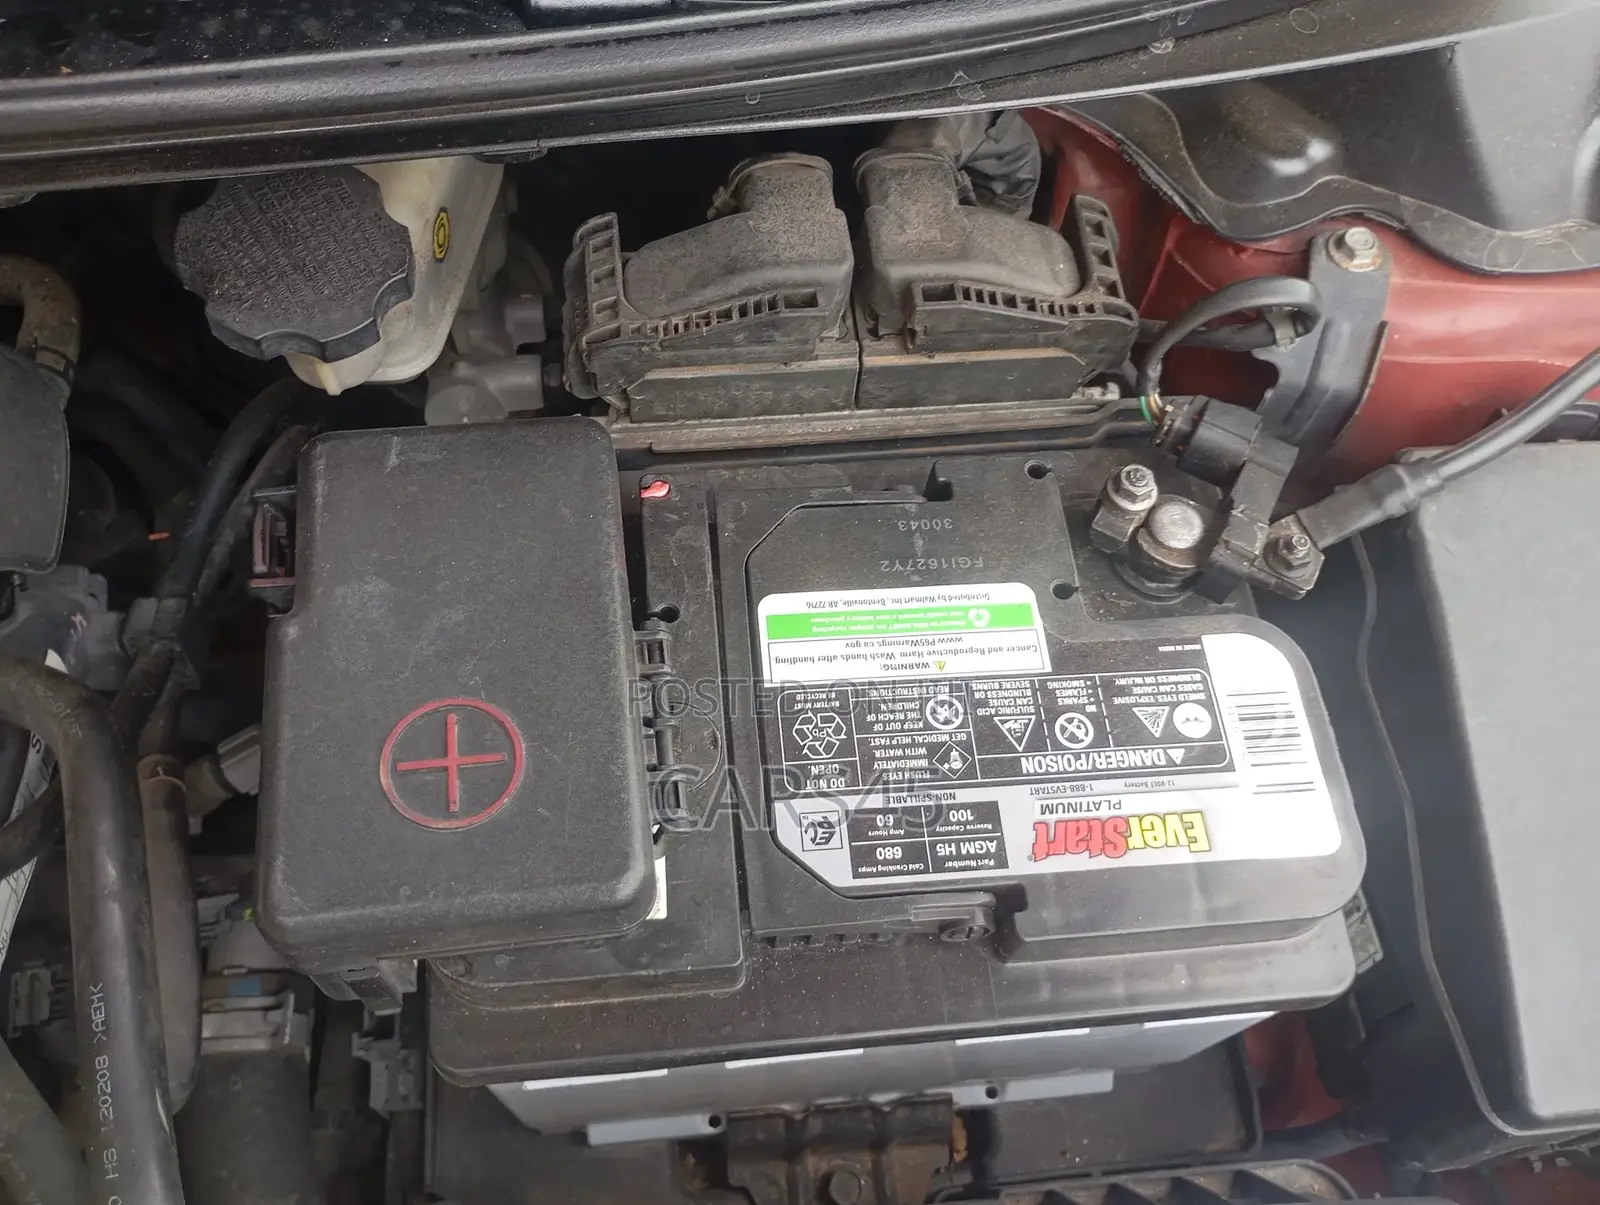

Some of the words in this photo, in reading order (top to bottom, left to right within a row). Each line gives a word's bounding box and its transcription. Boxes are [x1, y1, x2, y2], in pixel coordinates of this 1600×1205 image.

[904, 596, 936, 604] Walmart
[938, 594, 946, 602] by
[947, 593, 990, 602] Distributed
[806, 601, 826, 609] 72716
[828, 600, 838, 608] AR
[926, 646, 985, 657] Reproductive
[988, 647, 1003, 655] and
[1006, 644, 1037, 653] Cancer
[817, 654, 838, 664] after
[840, 653, 867, 662] hands
[869, 652, 895, 661] Wash
[900, 650, 924, 659] Harm
[880, 662, 930, 671] WARNING:
[1113, 676, 1143, 685] INJURY.
[1144, 675, 1154, 683] OR
[1156, 673, 1201, 683] BLINDNESS
[969, 682, 999, 690] BURNS.
[1001, 680, 1030, 688] SEVERE
[1047, 680, 1085, 689] SMOKING
[1159, 684, 1176, 693] CAN
[1177, 683, 1203, 692] GASES
[928, 685, 950, 694] READ
[988, 689, 1031, 698] BLINDNESS
[1055, 688, 1087, 696] FLAMES
[1131, 685, 1158, 694] CAUSE
[1057, 696, 1089, 705] SPARKS
[1112, 695, 1153, 704] EXPLOSIVE
[1178, 692, 1206, 701] SHIELD
[793, 702, 813, 710] MUST
[813, 700, 840, 708] BATTERY
[879, 701, 920, 711] CHILDREN.
[988, 699, 1017, 707] CAUSE
[976, 706, 996, 715] ACID
[998, 705, 1035, 714] SULFURIC
[1085, 704, 1097, 712] NO
[866, 713, 876, 721] OF
[878, 712, 904, 720] REACH
[906, 711, 921, 719] THE
[873, 723, 883, 731] OF
[884, 721, 900, 730] OUT
[903, 720, 923, 729] KEEP
[812, 728, 827, 737] Pb
[951, 732, 967, 740] GET
[868, 737, 889, 746] FAST.
[891, 735, 911, 744] HELP
[913, 733, 950, 742] MEDICAL
[872, 748, 902, 757] WATER.
[902, 747, 927, 756] WITH
[873, 759, 928, 769] IMMEDIATELY
[1020, 749, 1166, 773] DANGER/POISON
[808, 764, 839, 775] OPEN.
[882, 772, 903, 780] EYES
[905, 770, 930, 779] FLUSH
[805, 779, 828, 789] NOT
[830, 778, 845, 787] DO
[1124, 780, 1149, 790] Battery
[1029, 783, 1094, 795] 1-888-EVSTART
[885, 792, 956, 805] NON-SPILLABLE
[1040, 799, 1122, 815] PLATINUM
[949, 809, 974, 822] 100
[876, 814, 894, 827] 60
[889, 827, 904, 836] Amp
[935, 823, 964, 833] Capacity
[966, 823, 993, 831] Reserve
[868, 829, 888, 838] Hours
[1031, 811, 1212, 862] EverStart
[936, 843, 955, 856] H5
[959, 839, 997, 855] AGM
[876, 846, 903, 860] 680
[910, 862, 924, 872] Cold
[944, 859, 976, 869] Number
[978, 858, 995, 867] Part
[858, 864, 876, 874] Amps
[878, 863, 908, 873] Cranking
